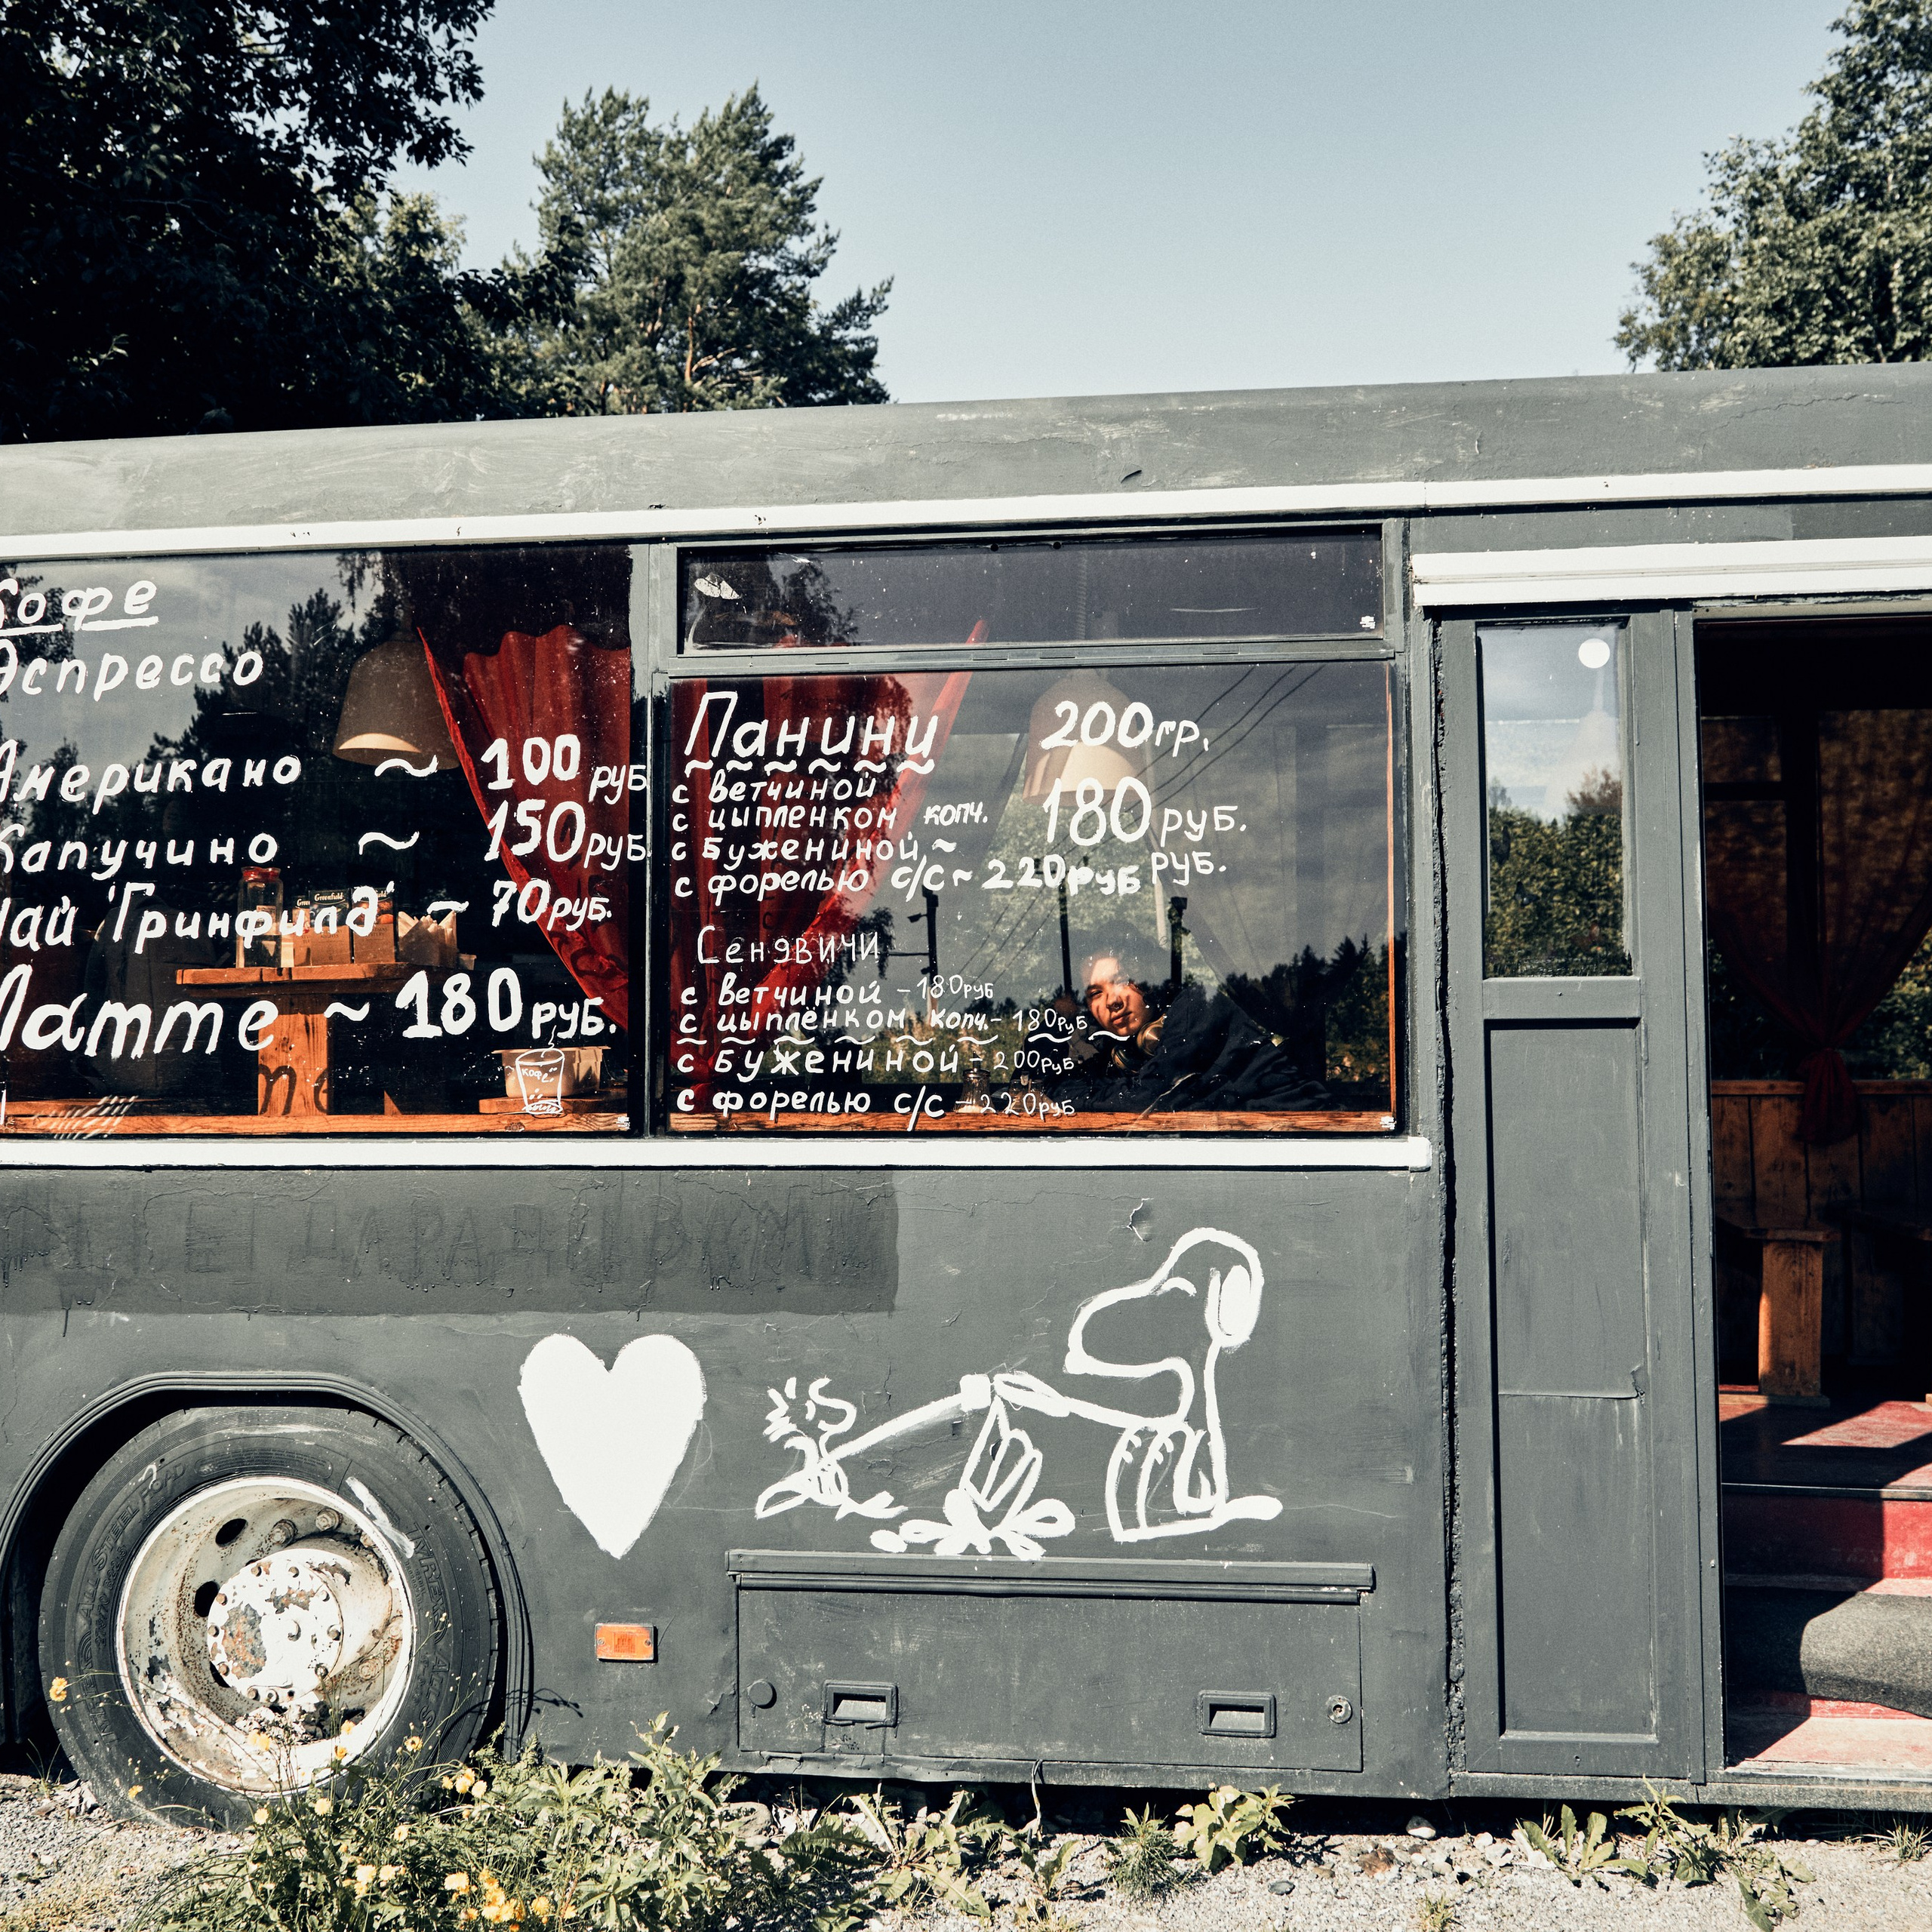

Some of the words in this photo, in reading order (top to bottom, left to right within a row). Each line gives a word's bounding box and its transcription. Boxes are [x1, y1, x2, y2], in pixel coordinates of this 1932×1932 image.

[685, 691, 938, 758] Панини
[481, 734, 580, 789] 100
[708, 768, 876, 803] ветчиной
[708, 806, 897, 830] цыпленком
[1043, 777, 1152, 846] 180
[315, 892, 344, 901] Greenfield
[708, 869, 868, 906] форелью
[718, 972, 881, 1008] ветчиной
[0, 964, 278, 1059] Латте
[395, 967, 524, 1038] 180
[712, 1091, 870, 1121] форелью
